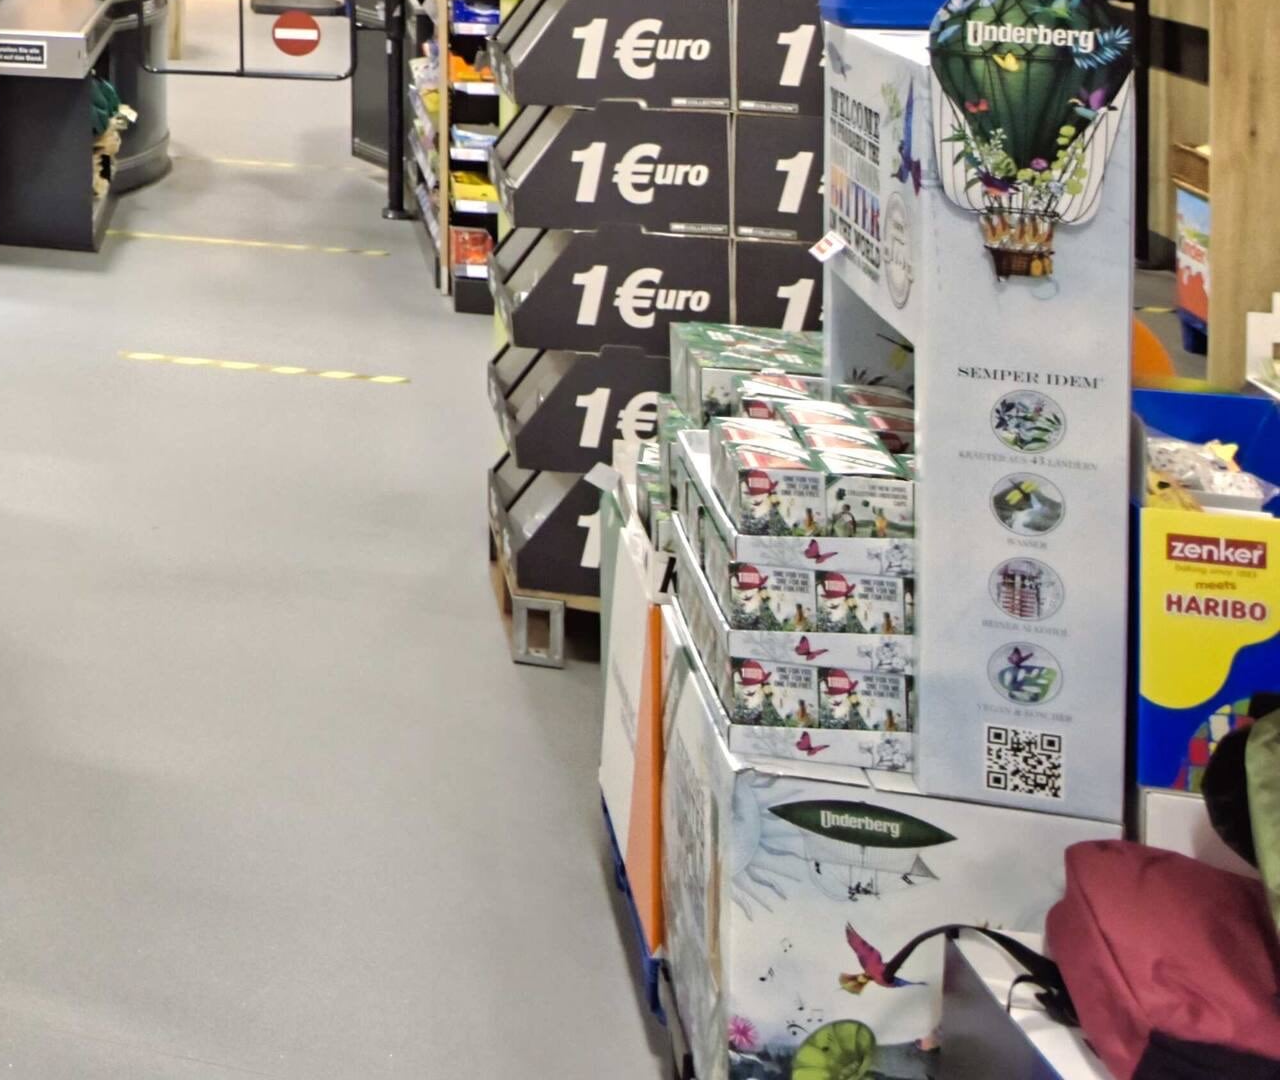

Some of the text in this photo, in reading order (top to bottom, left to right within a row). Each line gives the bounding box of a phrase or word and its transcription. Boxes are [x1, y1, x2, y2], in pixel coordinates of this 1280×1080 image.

[966, 19, 1095, 54] Underberg
[830, 86, 880, 139] WELCOME
[957, 366, 1098, 390] SEMPER IDEM
[1170, 536, 1264, 565] zenker
[1195, 581, 1237, 590] meets
[1166, 593, 1267, 621] HARIBO
[820, 810, 901, 838] Underberg
